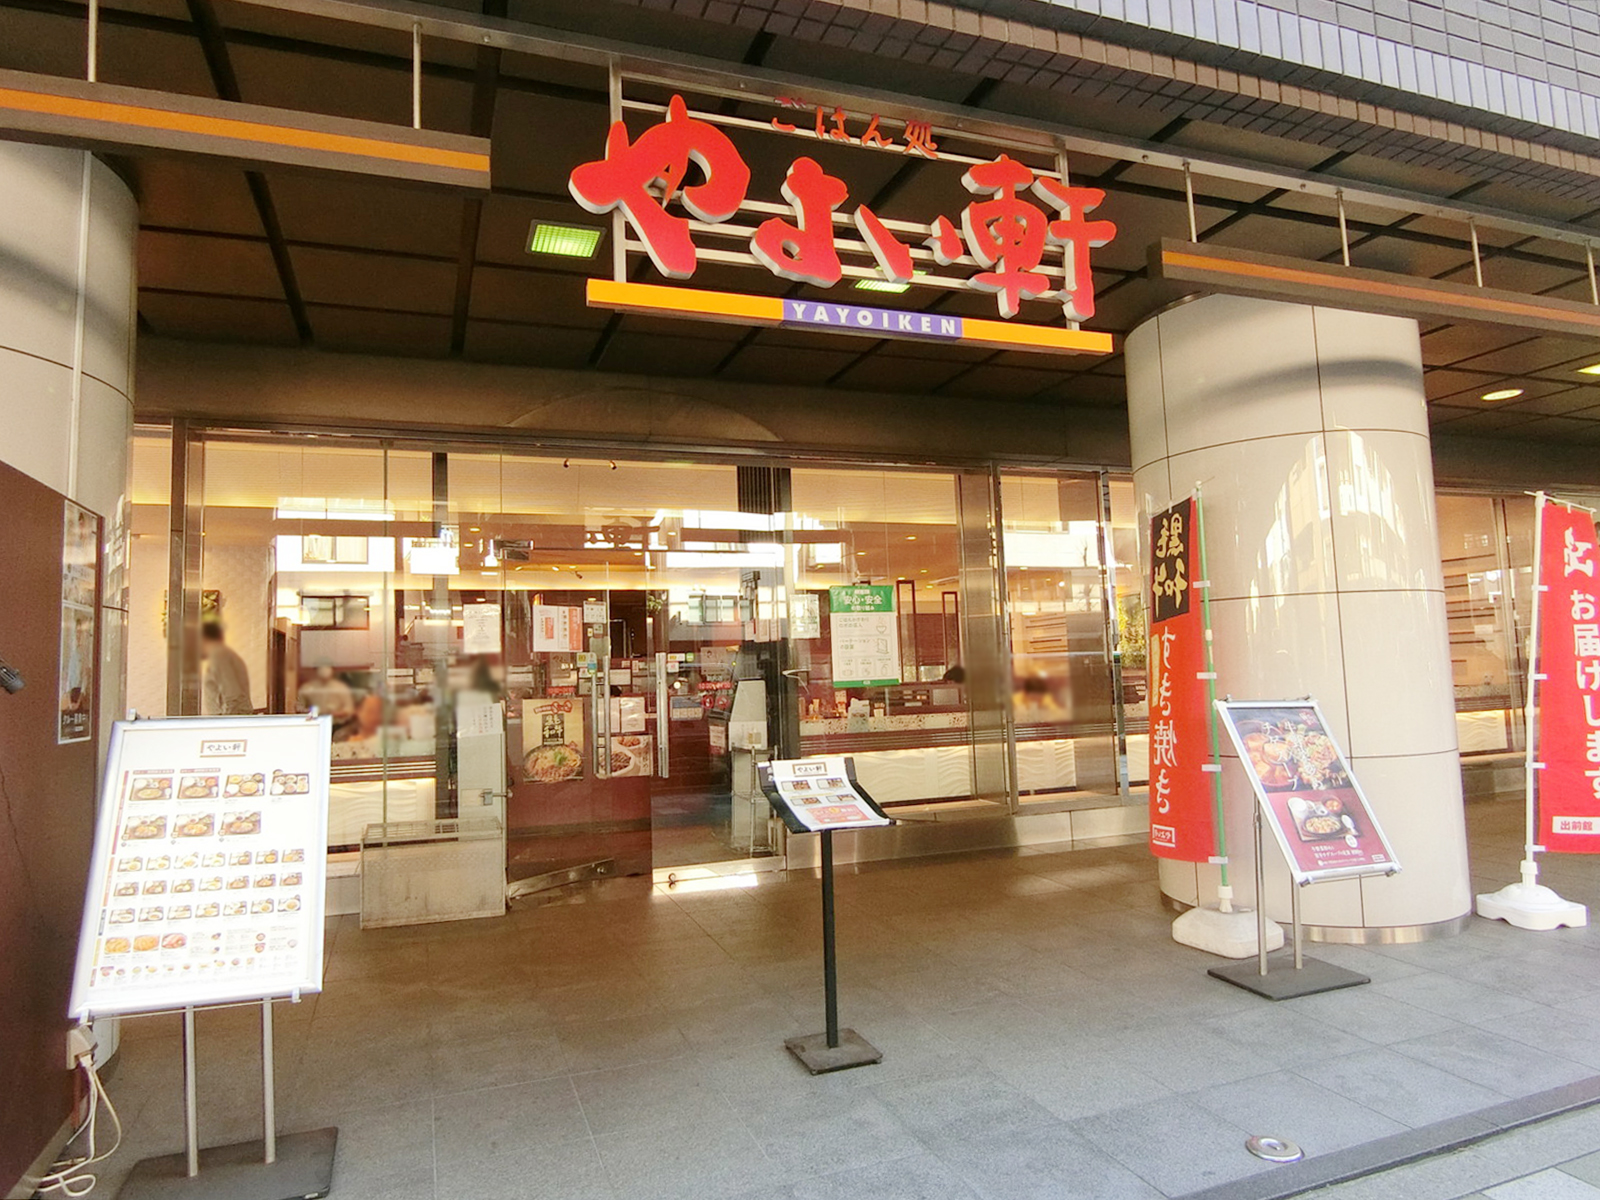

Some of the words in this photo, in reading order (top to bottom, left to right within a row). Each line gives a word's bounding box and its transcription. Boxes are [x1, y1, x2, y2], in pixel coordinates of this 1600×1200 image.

[771, 96, 939, 160] ごはん処
[567, 93, 1117, 323] やよい軒
[791, 303, 956, 335] YAYOIKEN
[843, 595, 883, 605] 安心・安全
[206, 743, 241, 752] やよい軒
[1559, 820, 1593, 832] 出前館
